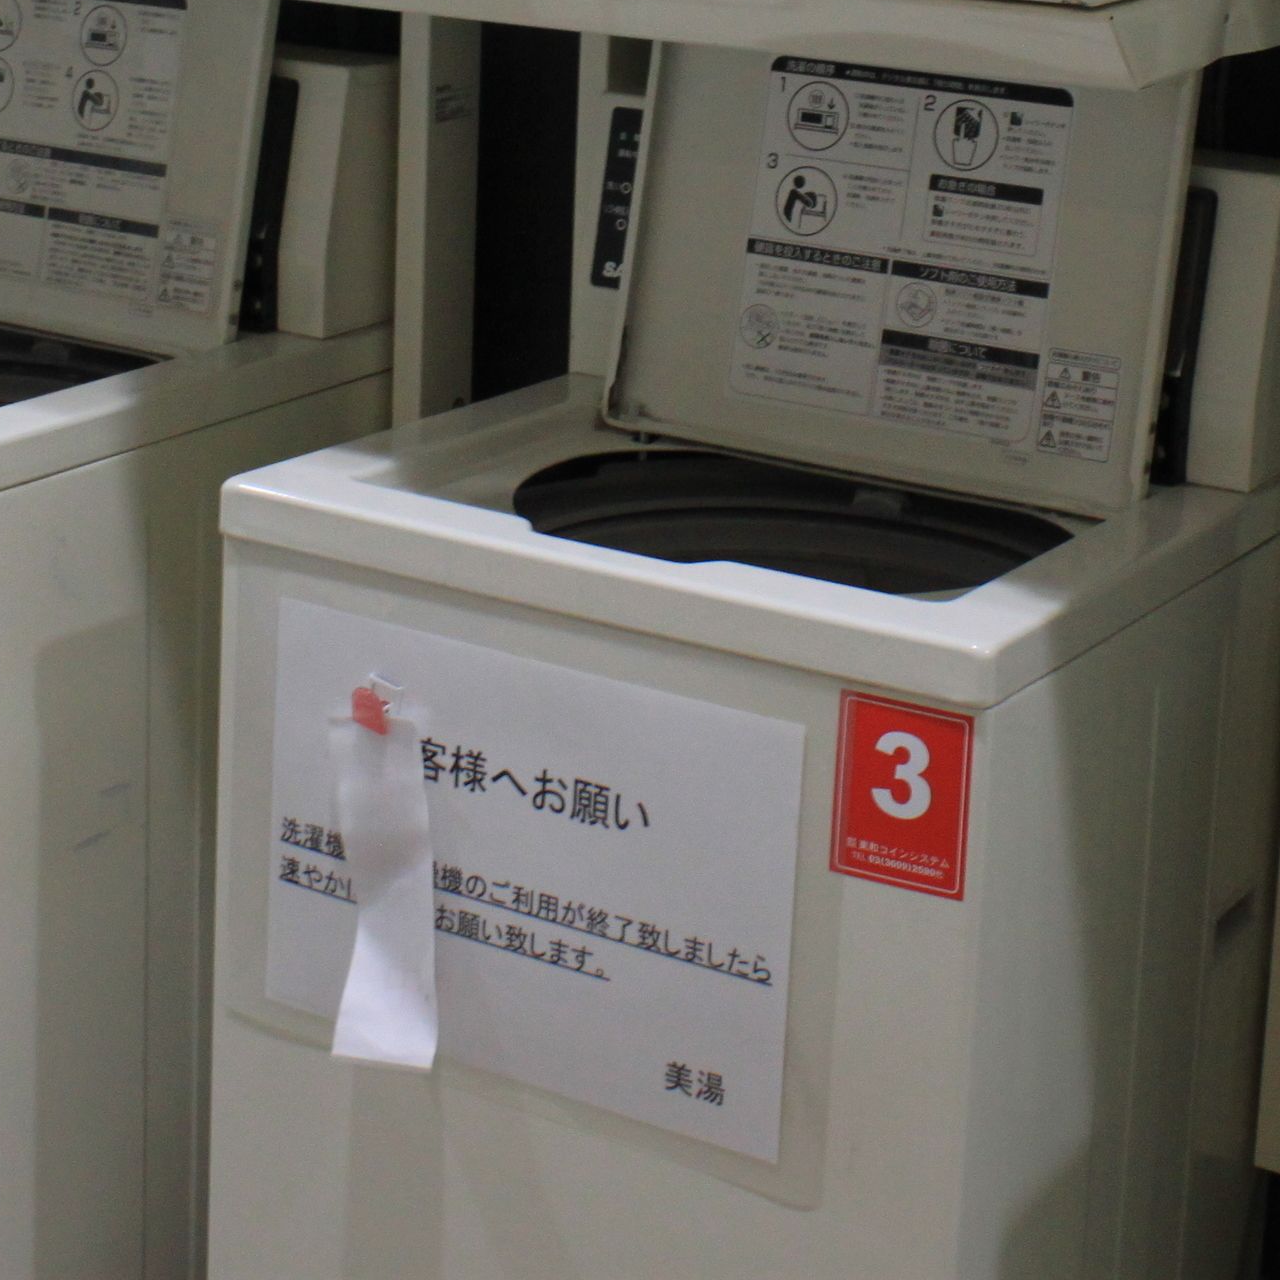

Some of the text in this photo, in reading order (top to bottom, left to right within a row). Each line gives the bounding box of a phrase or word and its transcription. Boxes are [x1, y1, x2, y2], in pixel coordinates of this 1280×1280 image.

[923, 94, 937, 111] 2
[766, 152, 779, 169] 3
[421, 737, 650, 830] 客様へお願い
[871, 731, 932, 820] 3
[280, 816, 772, 983] 洗濯機 機のご利用が終了致しましたら
[435, 904, 606, 978] お願い致します。
[665, 1061, 726, 1107] 美湯
